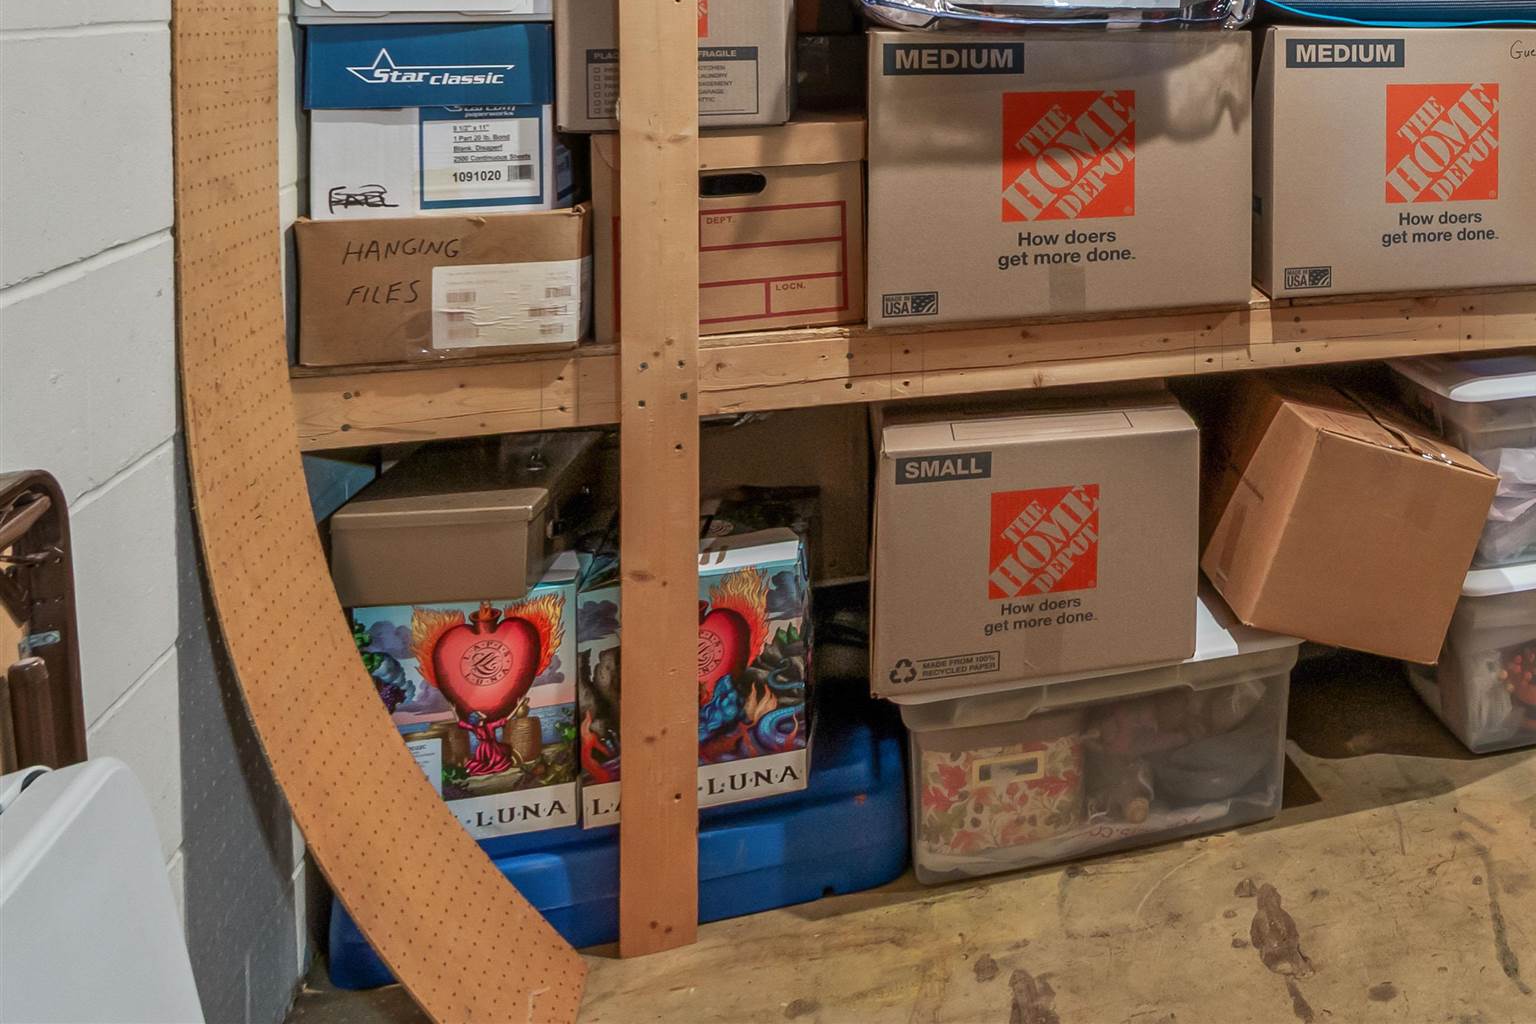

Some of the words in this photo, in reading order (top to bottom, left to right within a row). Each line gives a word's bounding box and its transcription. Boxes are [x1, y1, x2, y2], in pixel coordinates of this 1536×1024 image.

[895, 48, 1013, 70] MEDIUM
[1295, 43, 1396, 63] MEDIUM
[373, 67, 431, 84] Star
[429, 72, 505, 86] classic
[1015, 104, 1073, 157] THE
[1396, 96, 1446, 145] THE
[1385, 83, 1500, 203] HOME
[1002, 90, 1136, 221] HOME
[1431, 126, 1499, 202] DEPOT
[452, 170, 501, 183] 1091020
[1055, 137, 1136, 220] DEPOT
[706, 216, 736, 225] DEPT.
[1399, 212, 1434, 226] How
[1438, 211, 1482, 225] doers
[1018, 232, 1059, 247] How
[1065, 230, 1117, 245] doers
[1382, 230, 1408, 247] get
[1412, 230, 1453, 243] more
[1457, 228, 1499, 241] done.
[342, 238, 459, 265] HANGING
[998, 251, 1028, 270] get
[1034, 251, 1081, 265] more
[1086, 247, 1136, 262] done.
[775, 282, 806, 291] LOCN.
[1287, 275, 1307, 287] USA
[345, 279, 421, 306] FILES
[886, 302, 909, 315] USA
[904, 457, 983, 480] SMALL
[1000, 499, 1048, 545] THE
[989, 484, 1100, 598] HOME
[1032, 522, 1099, 593] DEPOT
[1001, 603, 1034, 616] How
[1039, 598, 1081, 611] doers
[984, 620, 1009, 637] get
[1013, 616, 1052, 630] more
[1056, 611, 1098, 625] done.
[922, 660, 947, 669] MADE
[949, 658, 973, 666] FROM
[975, 655, 996, 663] 100%
[922, 665, 967, 676] RECYCLED
[969, 662, 996, 671] PAPER
